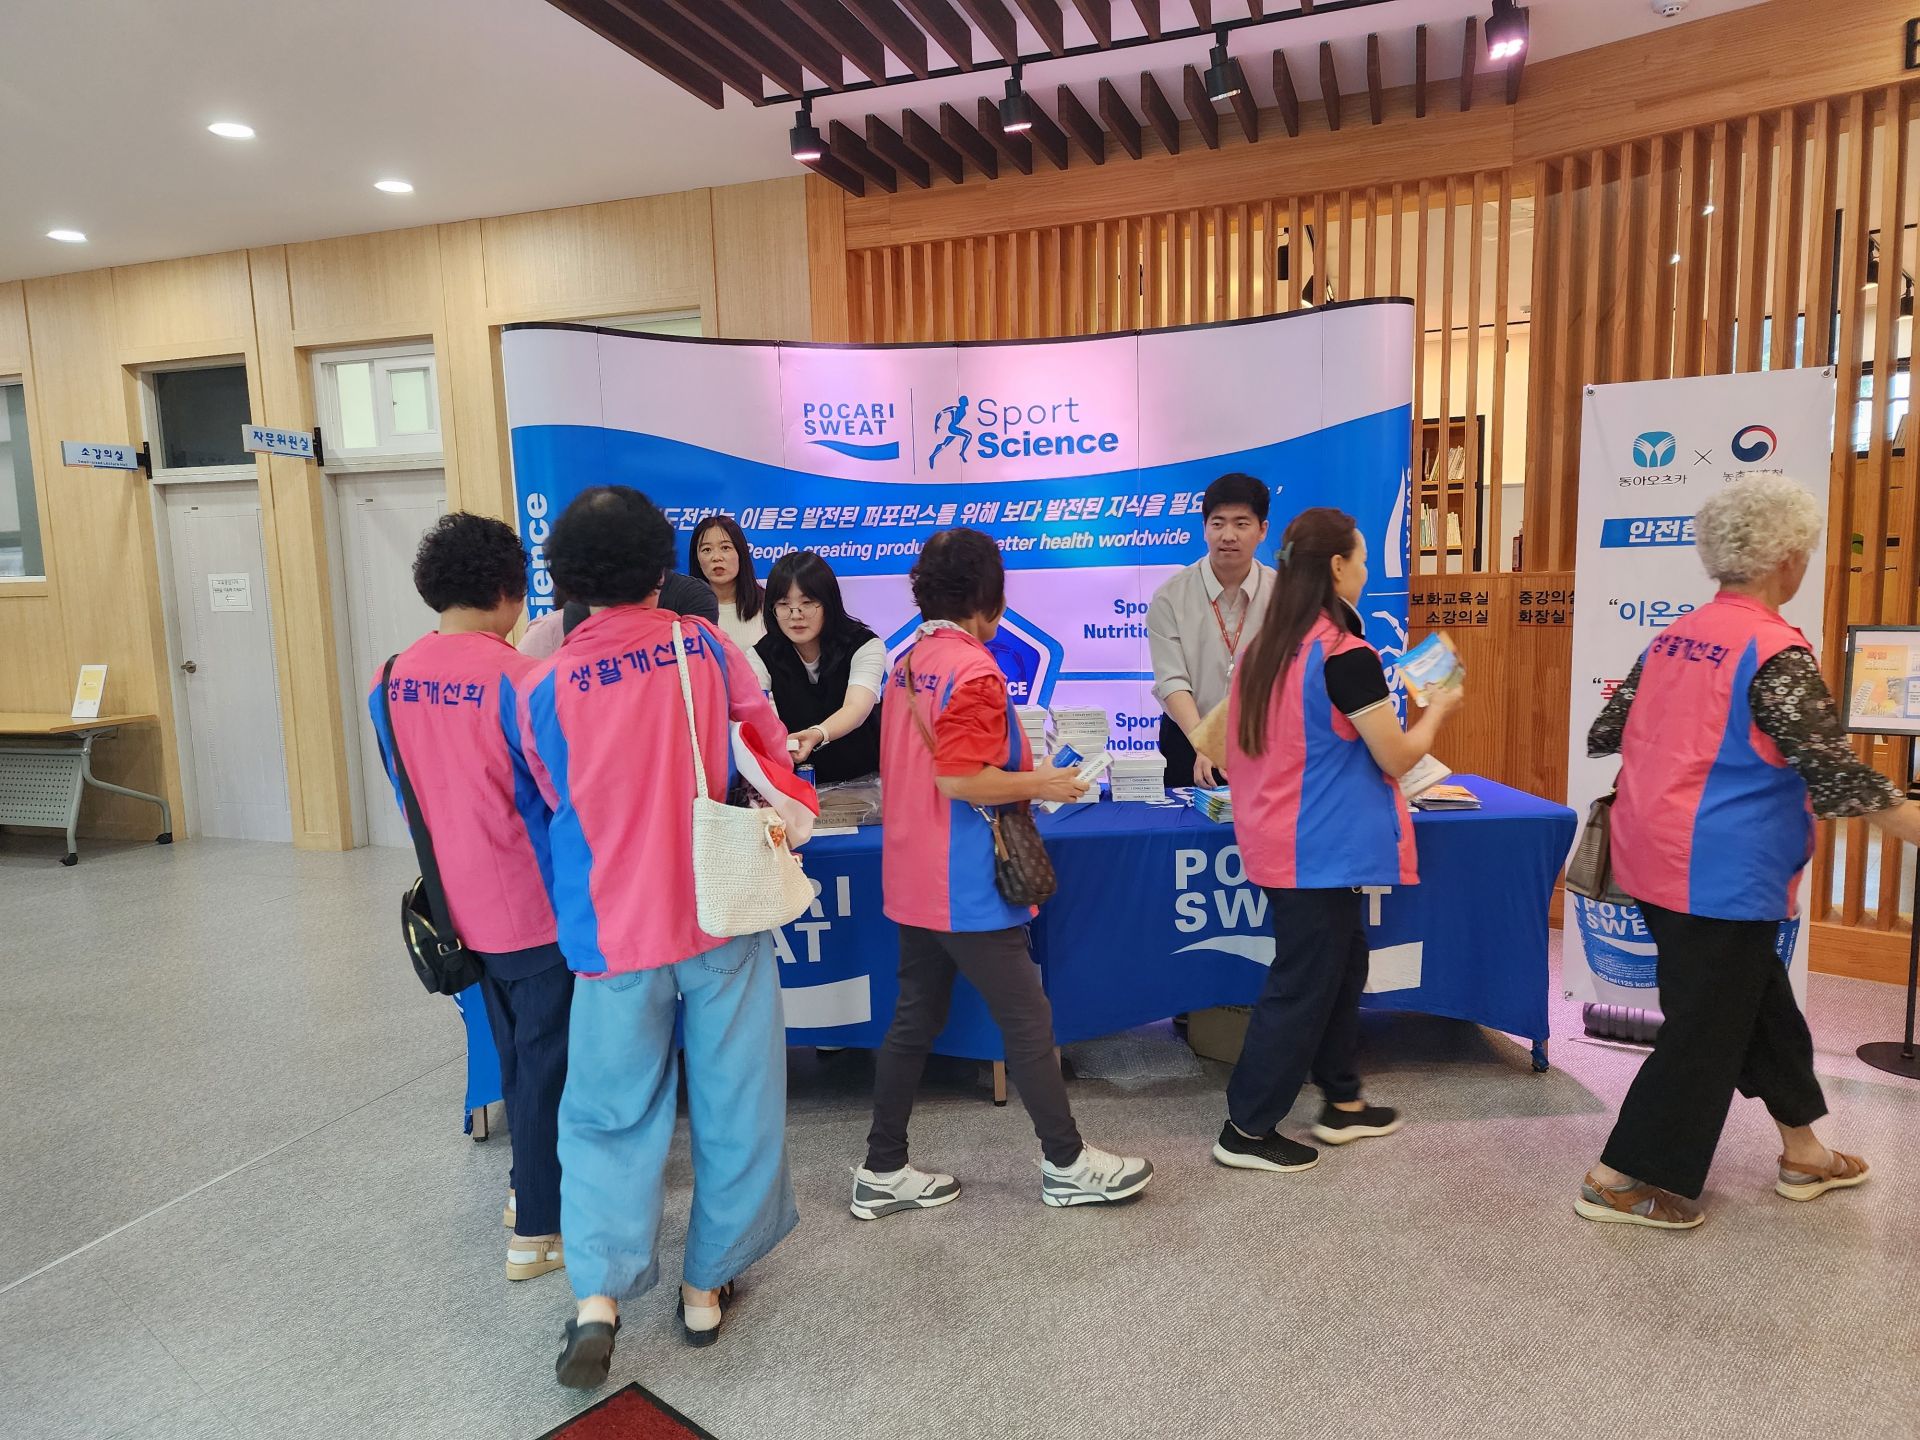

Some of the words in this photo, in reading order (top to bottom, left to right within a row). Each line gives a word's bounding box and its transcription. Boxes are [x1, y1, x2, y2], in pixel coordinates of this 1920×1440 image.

[803, 402, 894, 419] POCARI
[977, 397, 1079, 434] Sport
[804, 419, 887, 436] SWEAT
[253, 430, 310, 450] 자문위원실
[977, 431, 1119, 459] Science
[81, 447, 123, 461] 소강의실
[1618, 474, 1687, 487] 동아오츠카
[741, 507, 798, 529] 이들은
[801, 506, 860, 529] 발전된
[861, 503, 958, 528] 퍼포먼스를
[960, 501, 1000, 524] 위해
[1001, 499, 1042, 523] 보다
[1043, 497, 1104, 521] 발전된
[1104, 494, 1166, 517] 지식을
[1168, 491, 1206, 515] 필요
[526, 492, 555, 618] ience
[875, 538, 924, 561] produ
[996, 534, 1037, 551] etter
[1040, 531, 1093, 550] health
[1098, 527, 1191, 548] worldwide
[1114, 599, 1149, 618] Spo
[1411, 590, 1489, 606] 보화교육실
[1426, 609, 1489, 625] 소강의실
[1518, 609, 1566, 624] 화장실
[569, 634, 707, 693] 생활개선회
[387, 678, 486, 708] 생활개선회
[1586, 912, 1649, 936] SWE
